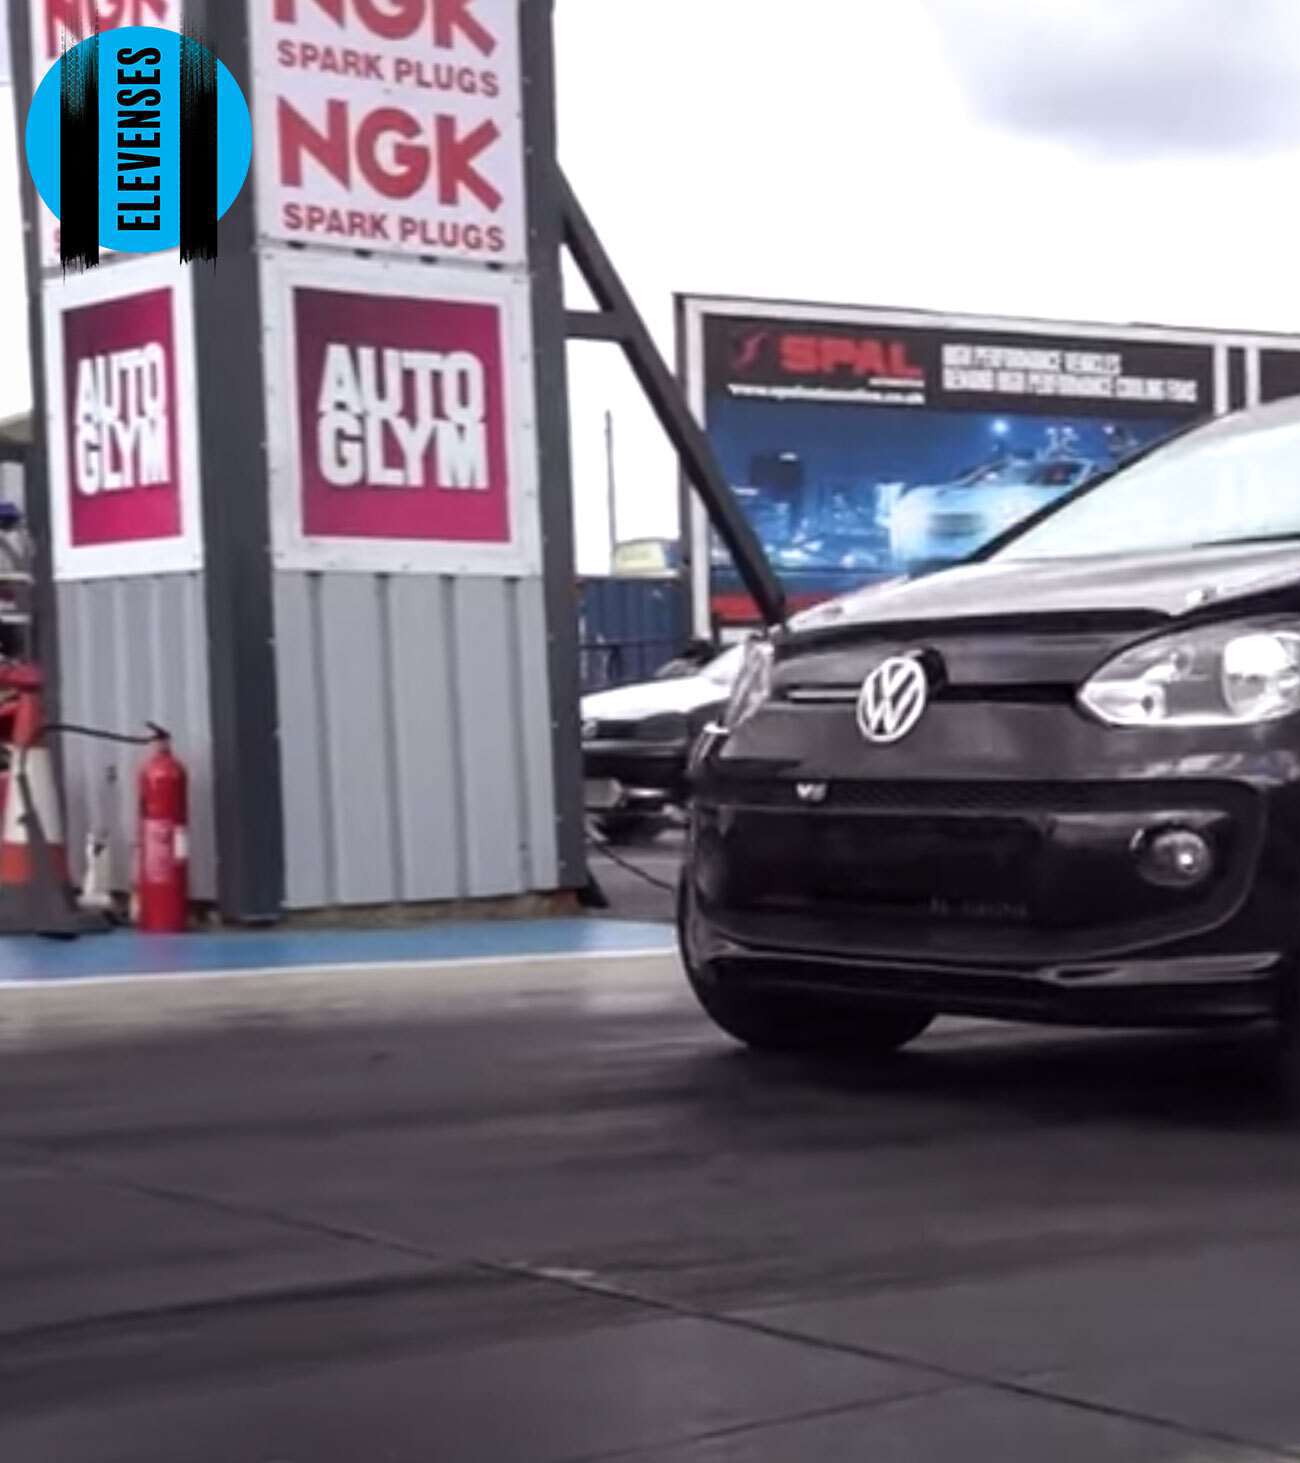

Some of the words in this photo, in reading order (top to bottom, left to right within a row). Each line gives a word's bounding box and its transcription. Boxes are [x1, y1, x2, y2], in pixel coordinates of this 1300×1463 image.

[277, 39, 384, 81] SPARK
[393, 57, 499, 98] PLUGS
[277, 95, 503, 213] NGK
[283, 202, 389, 240] SPARK
[399, 217, 505, 252] PLUGS
[75, 341, 166, 424] AUTO
[318, 343, 486, 424] AUTO
[781, 334, 924, 377] SPAL
[76, 407, 170, 494] GLYM
[318, 412, 491, 489] GLYM
